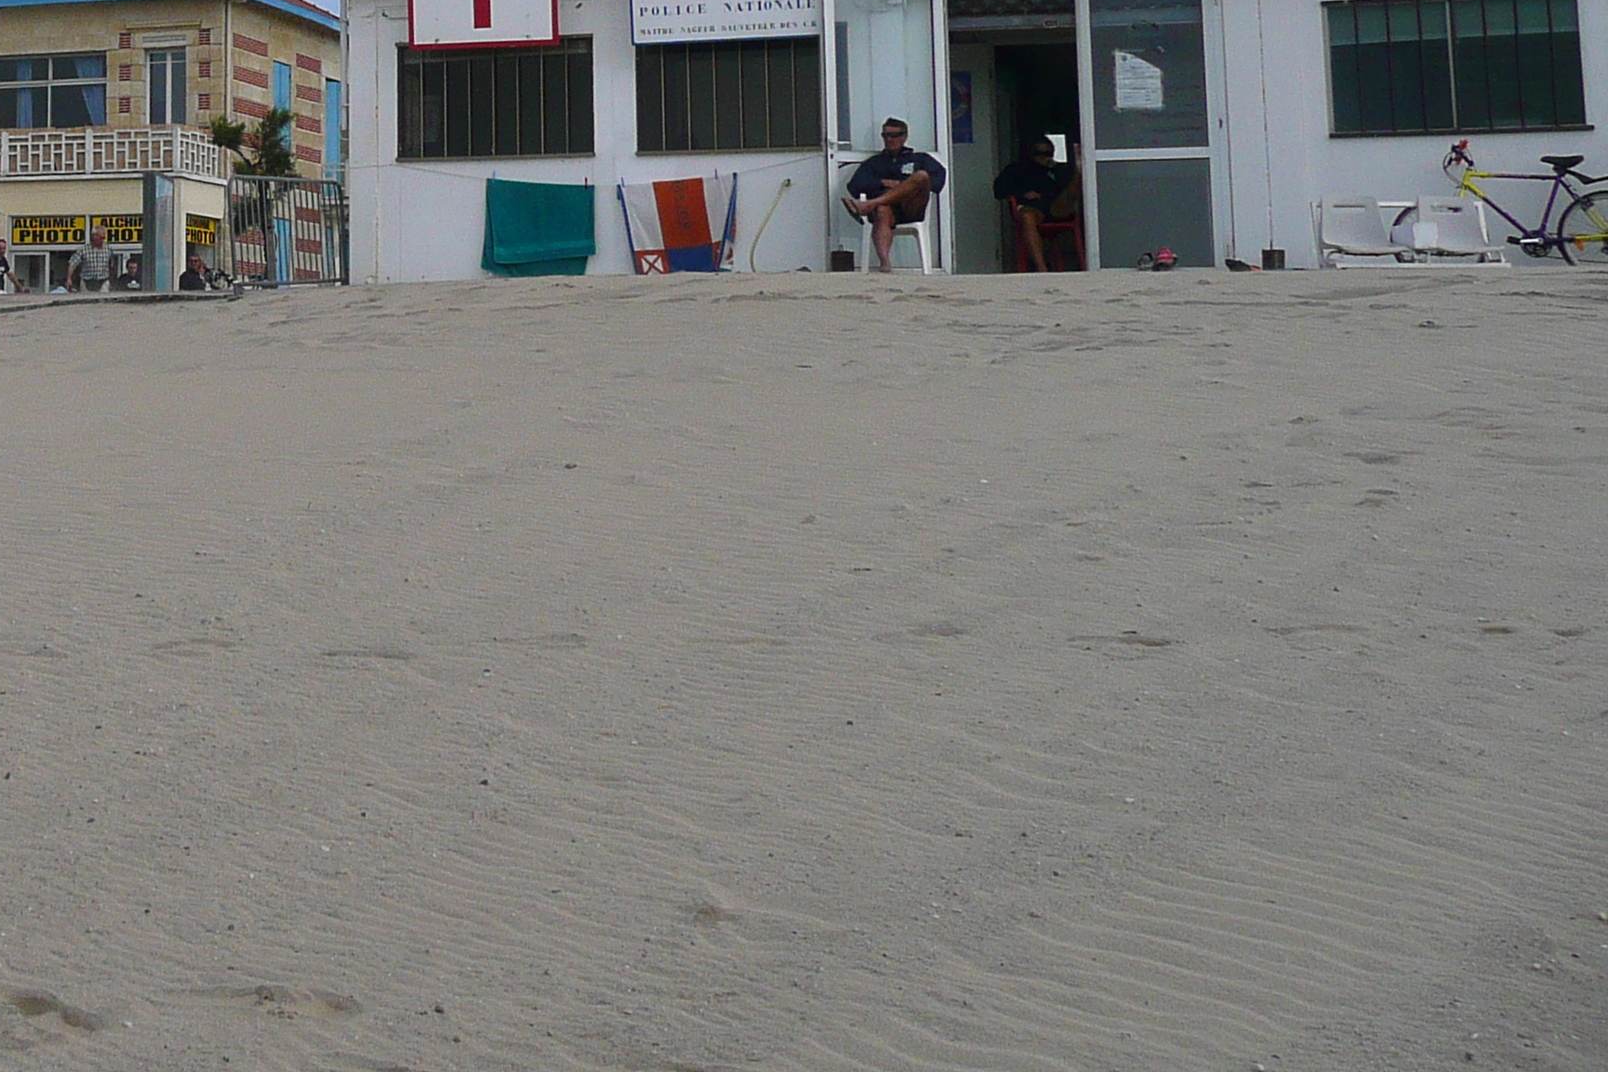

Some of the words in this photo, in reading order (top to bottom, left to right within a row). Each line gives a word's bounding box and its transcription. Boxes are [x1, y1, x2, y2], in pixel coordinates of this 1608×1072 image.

[639, 4, 707, 17] POLICE
[14, 217, 77, 228] ALCHIMIE
[19, 229, 85, 242] PHOTO
[186, 228, 215, 244] PHOTO
